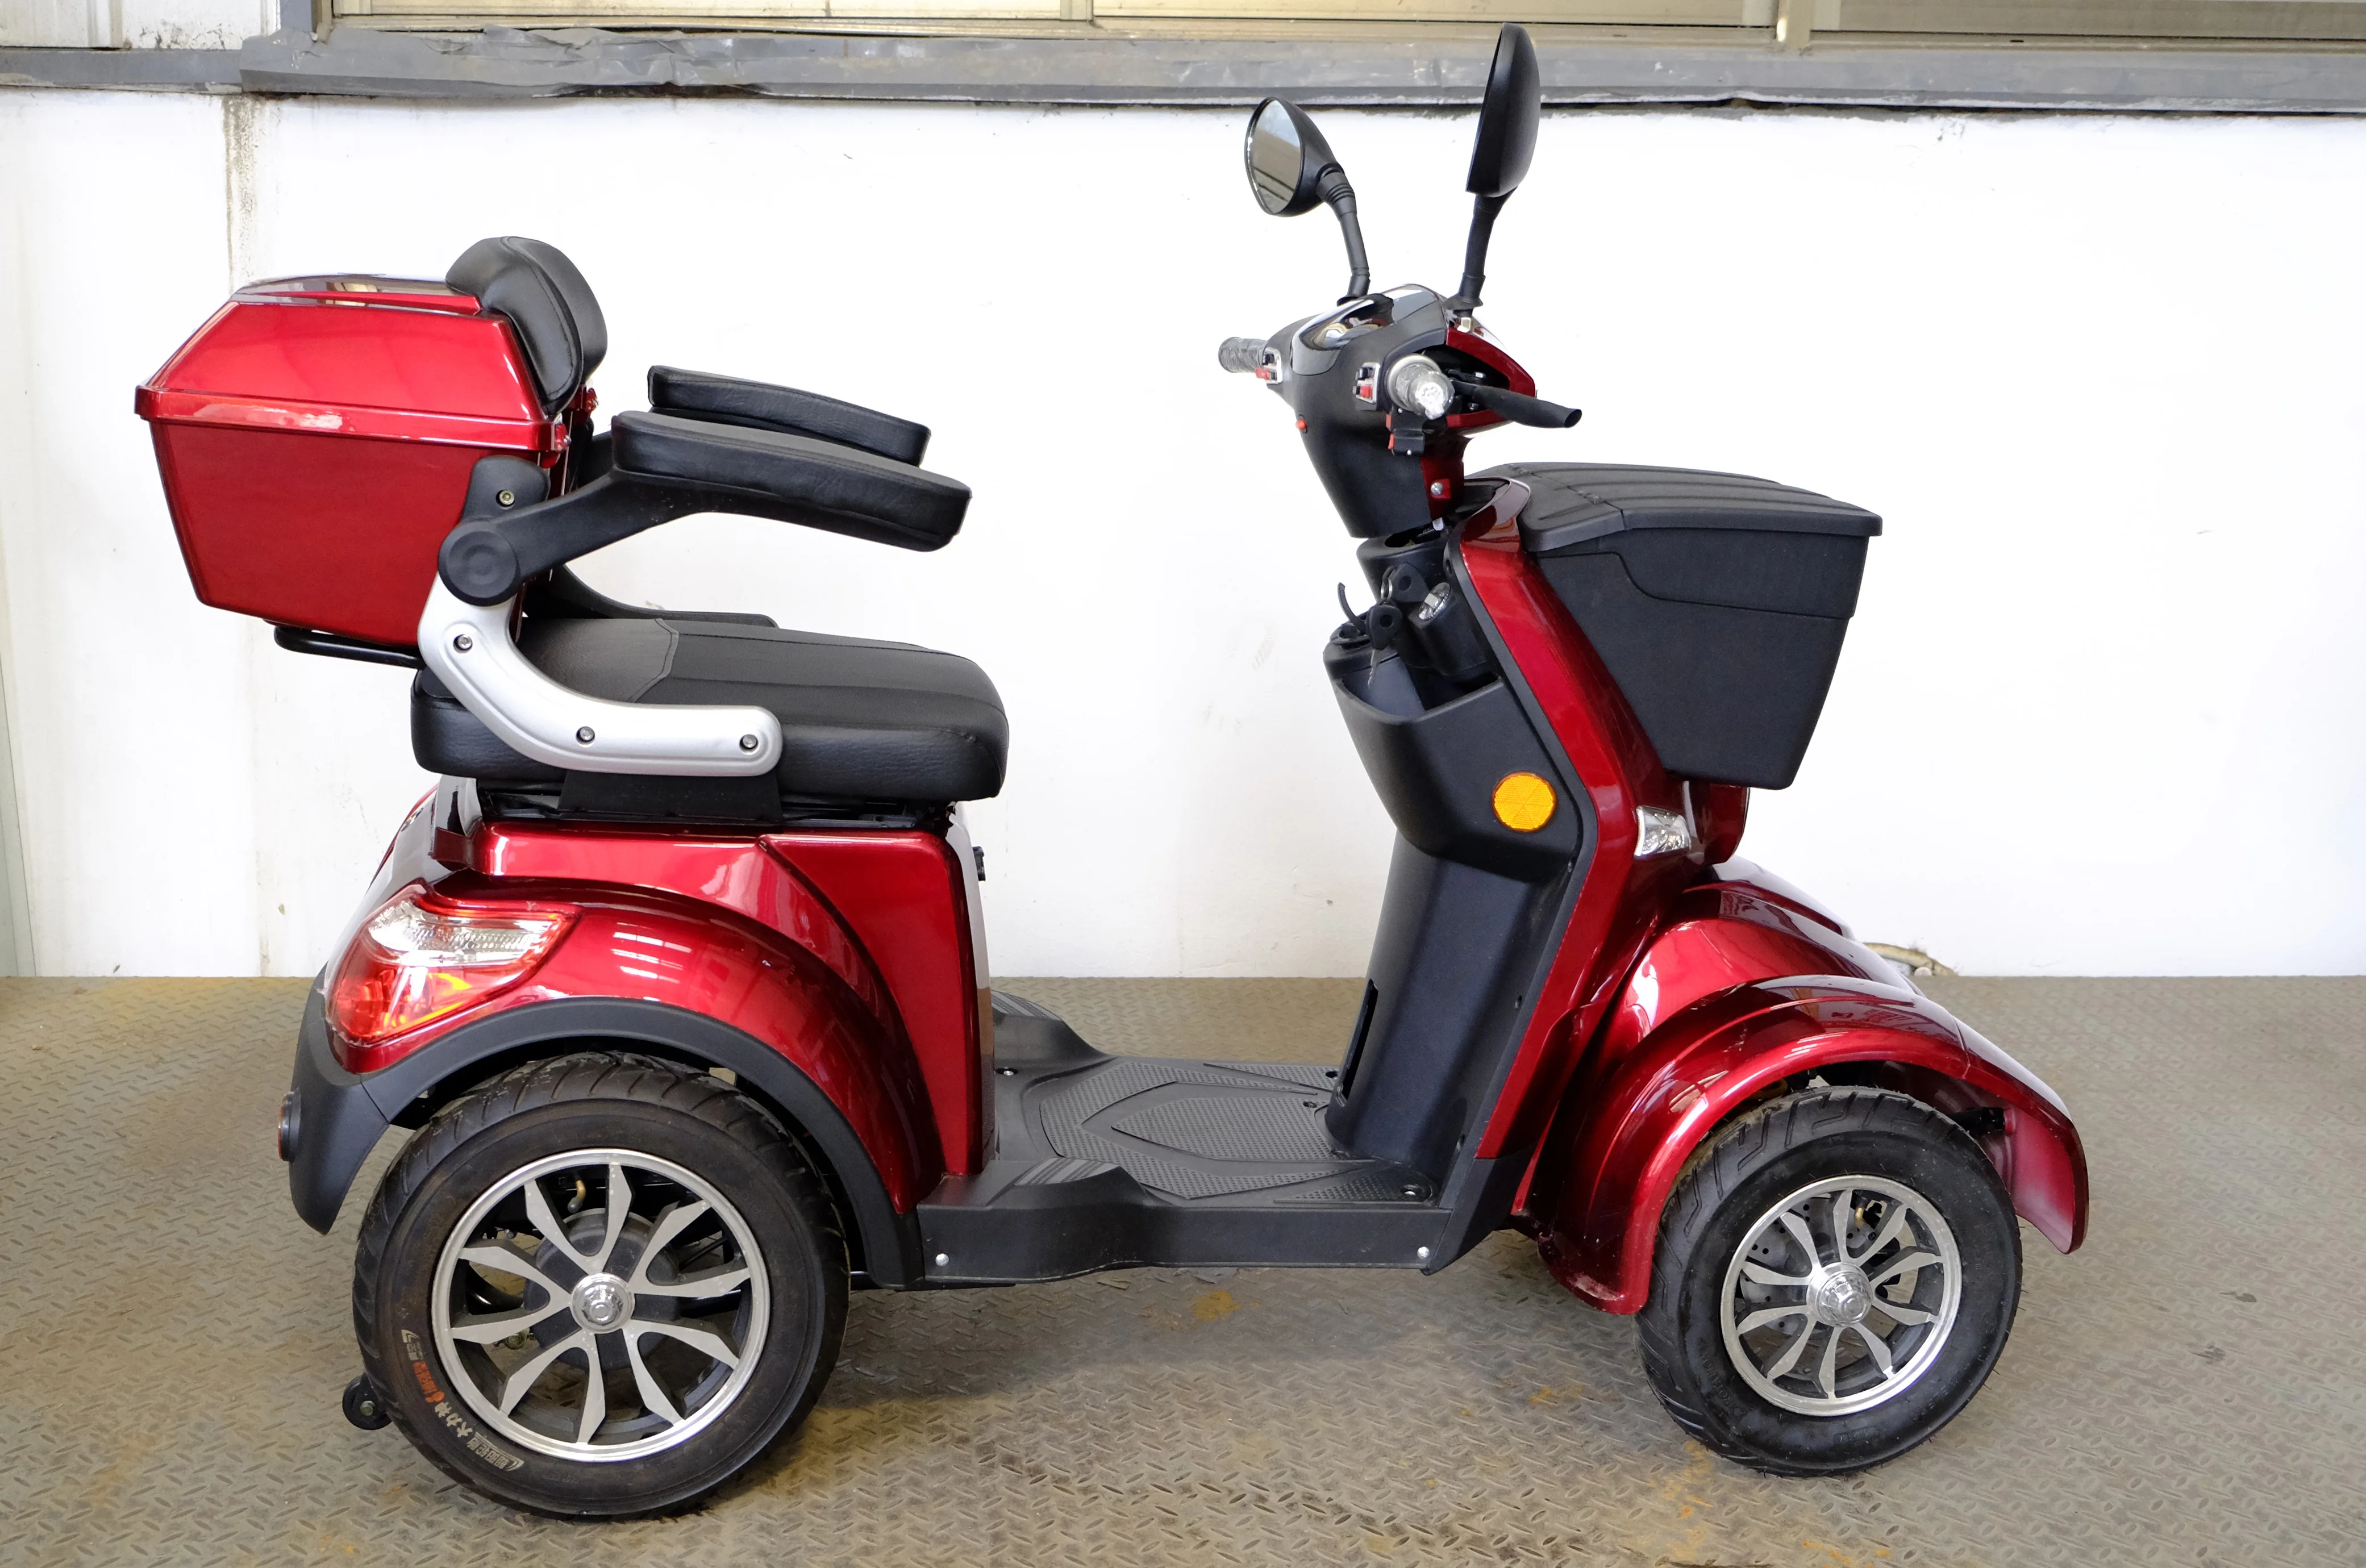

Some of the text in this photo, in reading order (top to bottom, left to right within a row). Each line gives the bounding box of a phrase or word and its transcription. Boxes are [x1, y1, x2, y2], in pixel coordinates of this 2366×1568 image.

[435, 1402, 473, 1438] 大力神
[467, 1437, 510, 1469] 朝阳轮胎
